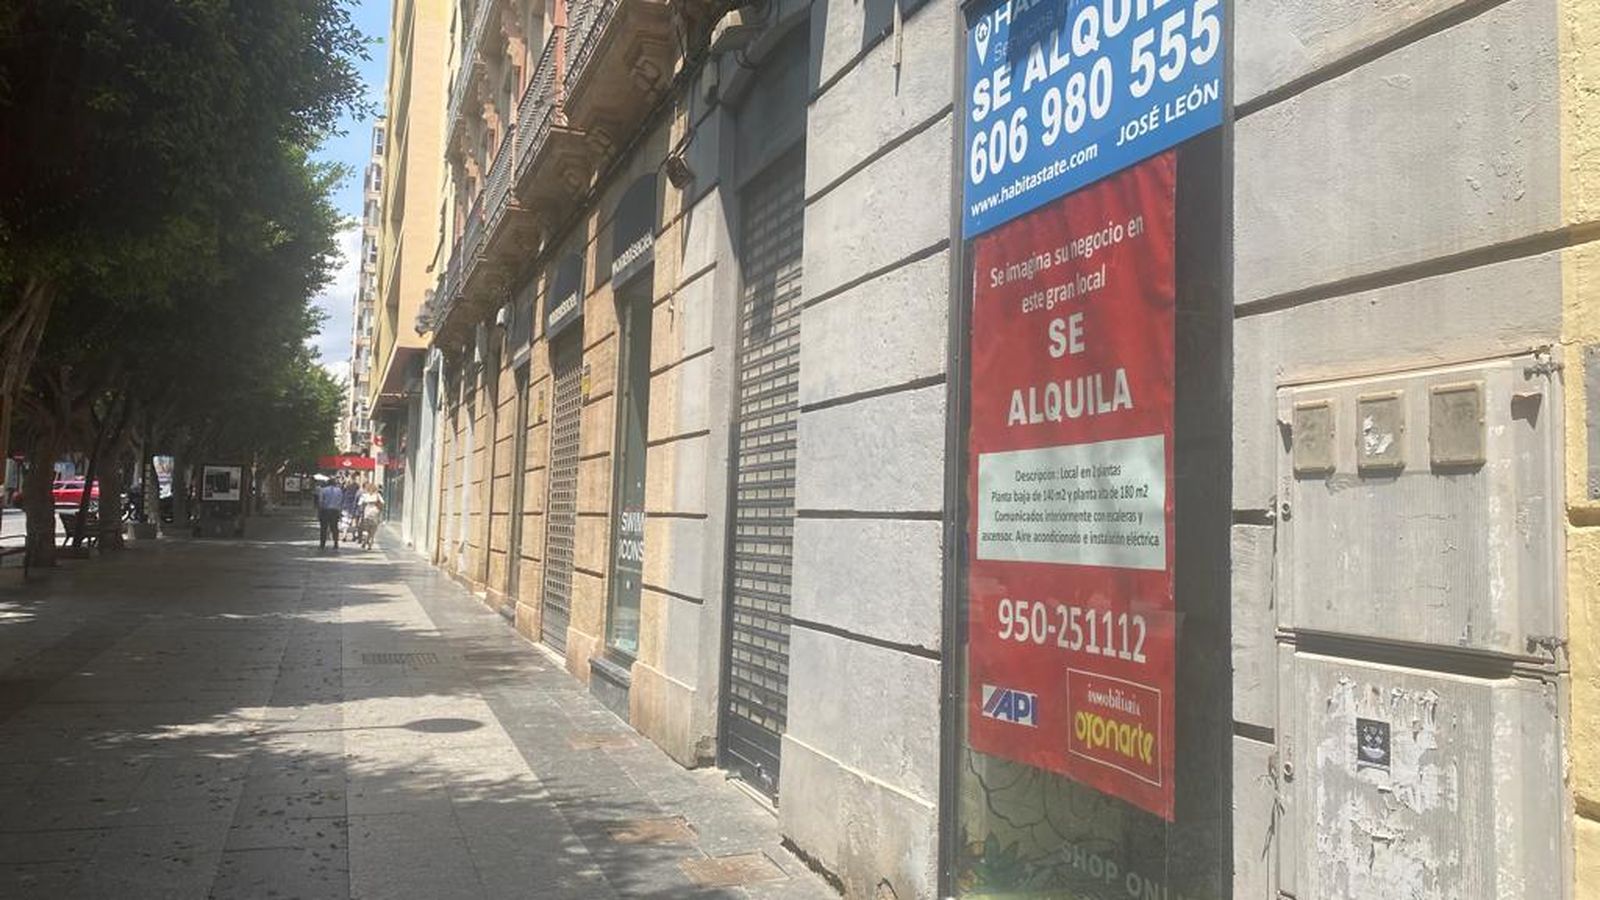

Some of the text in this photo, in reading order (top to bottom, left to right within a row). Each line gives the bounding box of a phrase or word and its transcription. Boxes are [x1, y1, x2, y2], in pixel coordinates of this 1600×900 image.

[971, 107, 1028, 184] 606
[1042, 56, 1113, 146] 980
[1129, 0, 1220, 98] 555
[973, 66, 1012, 122] SE
[1116, 79, 1219, 146] JOSÉ LEÓN
[971, 143, 1098, 217] www.habitastate.com
[990, 215, 1144, 288] Se imagina su negocio en
[1022, 263, 1106, 313] este gran local
[1048, 312, 1086, 358] SE
[1008, 368, 1134, 426] ALQUILA
[991, 490, 1012, 503] Planta
[1014, 489, 1031, 505] baja
[1032, 489, 1042, 502] de
[1073, 487, 1097, 503] planta
[1110, 485, 1119, 500] de
[1120, 484, 1135, 499] 180
[1136, 483, 1149, 499] m2
[1060, 465, 1079, 480] Local
[1080, 467, 1091, 479] en
[994, 509, 1044, 522] Comunicados
[1137, 511, 1143, 526] y
[1082, 533, 1089, 545] e
[997, 598, 1147, 664] 950-251112
[1062, 841, 1118, 885] SHOP
